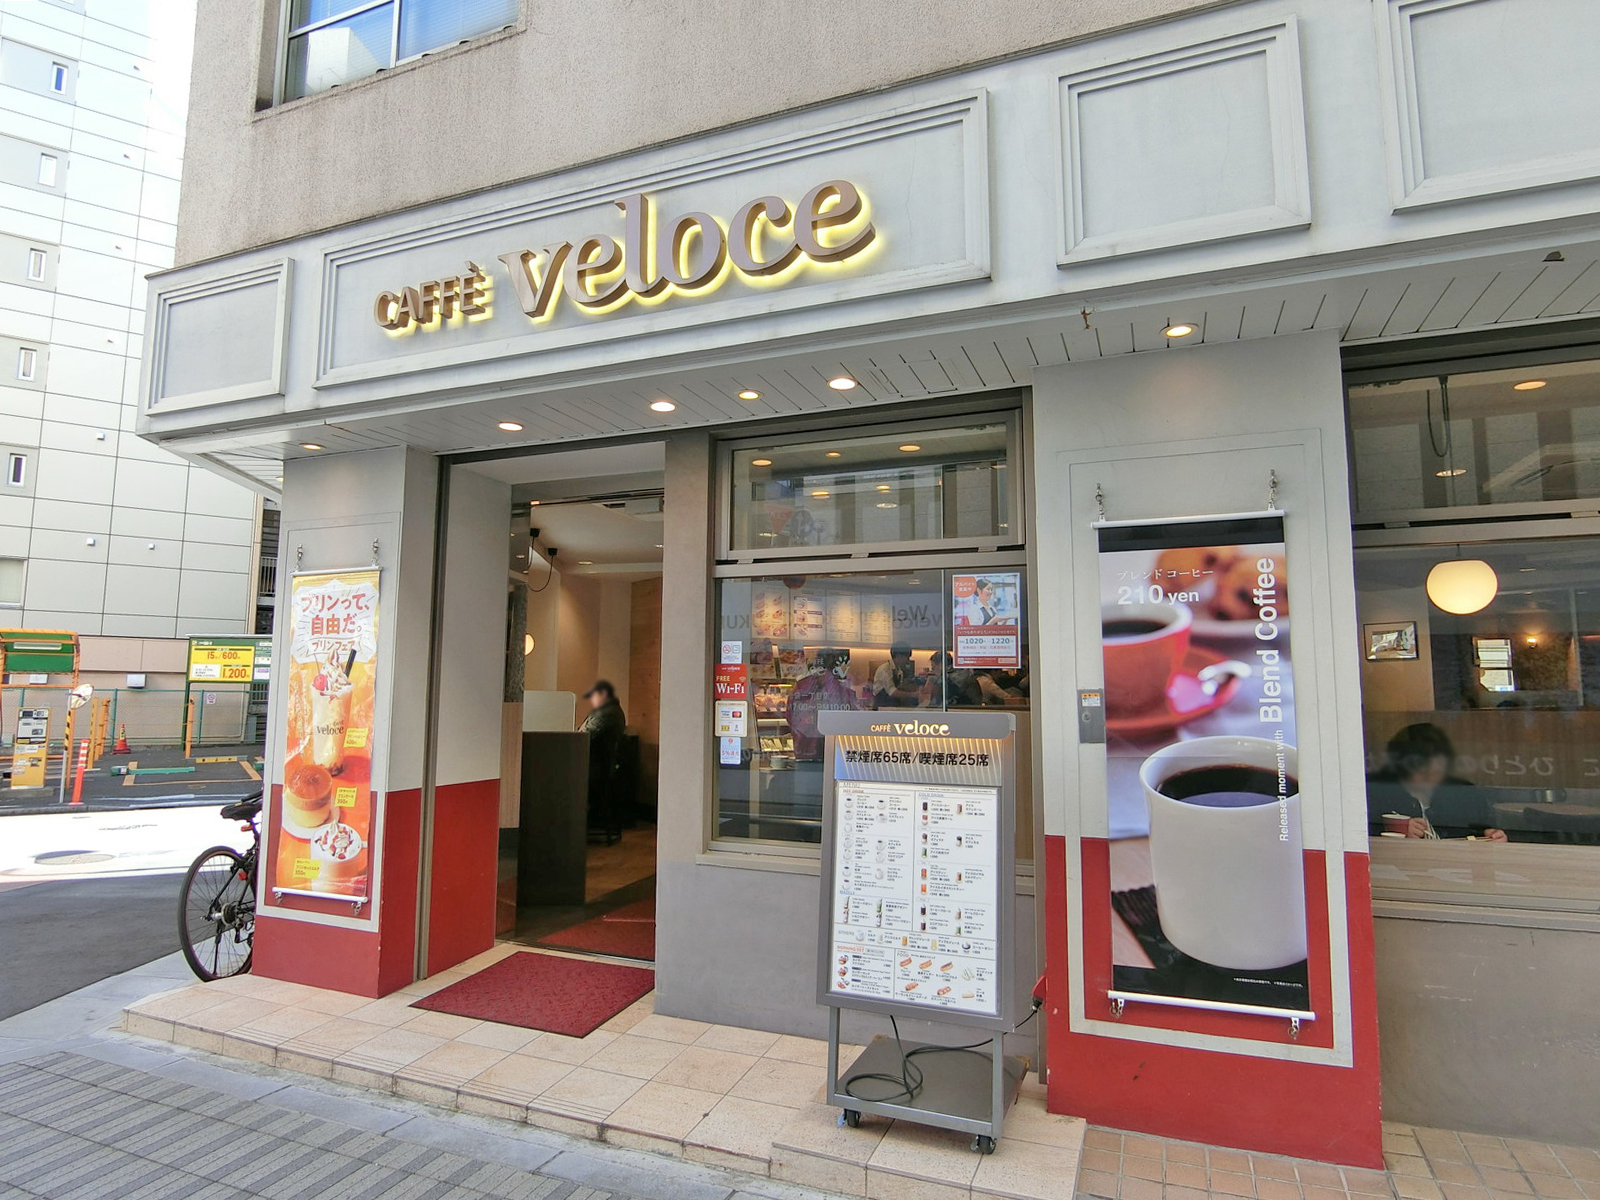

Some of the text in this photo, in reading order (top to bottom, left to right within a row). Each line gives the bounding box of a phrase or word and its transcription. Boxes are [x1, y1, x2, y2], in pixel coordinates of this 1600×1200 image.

[374, 180, 876, 331] CAFFÈ veloce
[1117, 568, 1214, 580] ブレンドコーヒー
[1117, 584, 1200, 605] 210 yen
[311, 613, 362, 636] 自由だ。
[716, 682, 745, 694] Wi-Fi
[1252, 557, 1289, 841] Released moment with Blend Coffee
[870, 720, 951, 736] CAFFÈ veloce
[845, 750, 989, 767] 禁煙席65席/喫煙席25席
